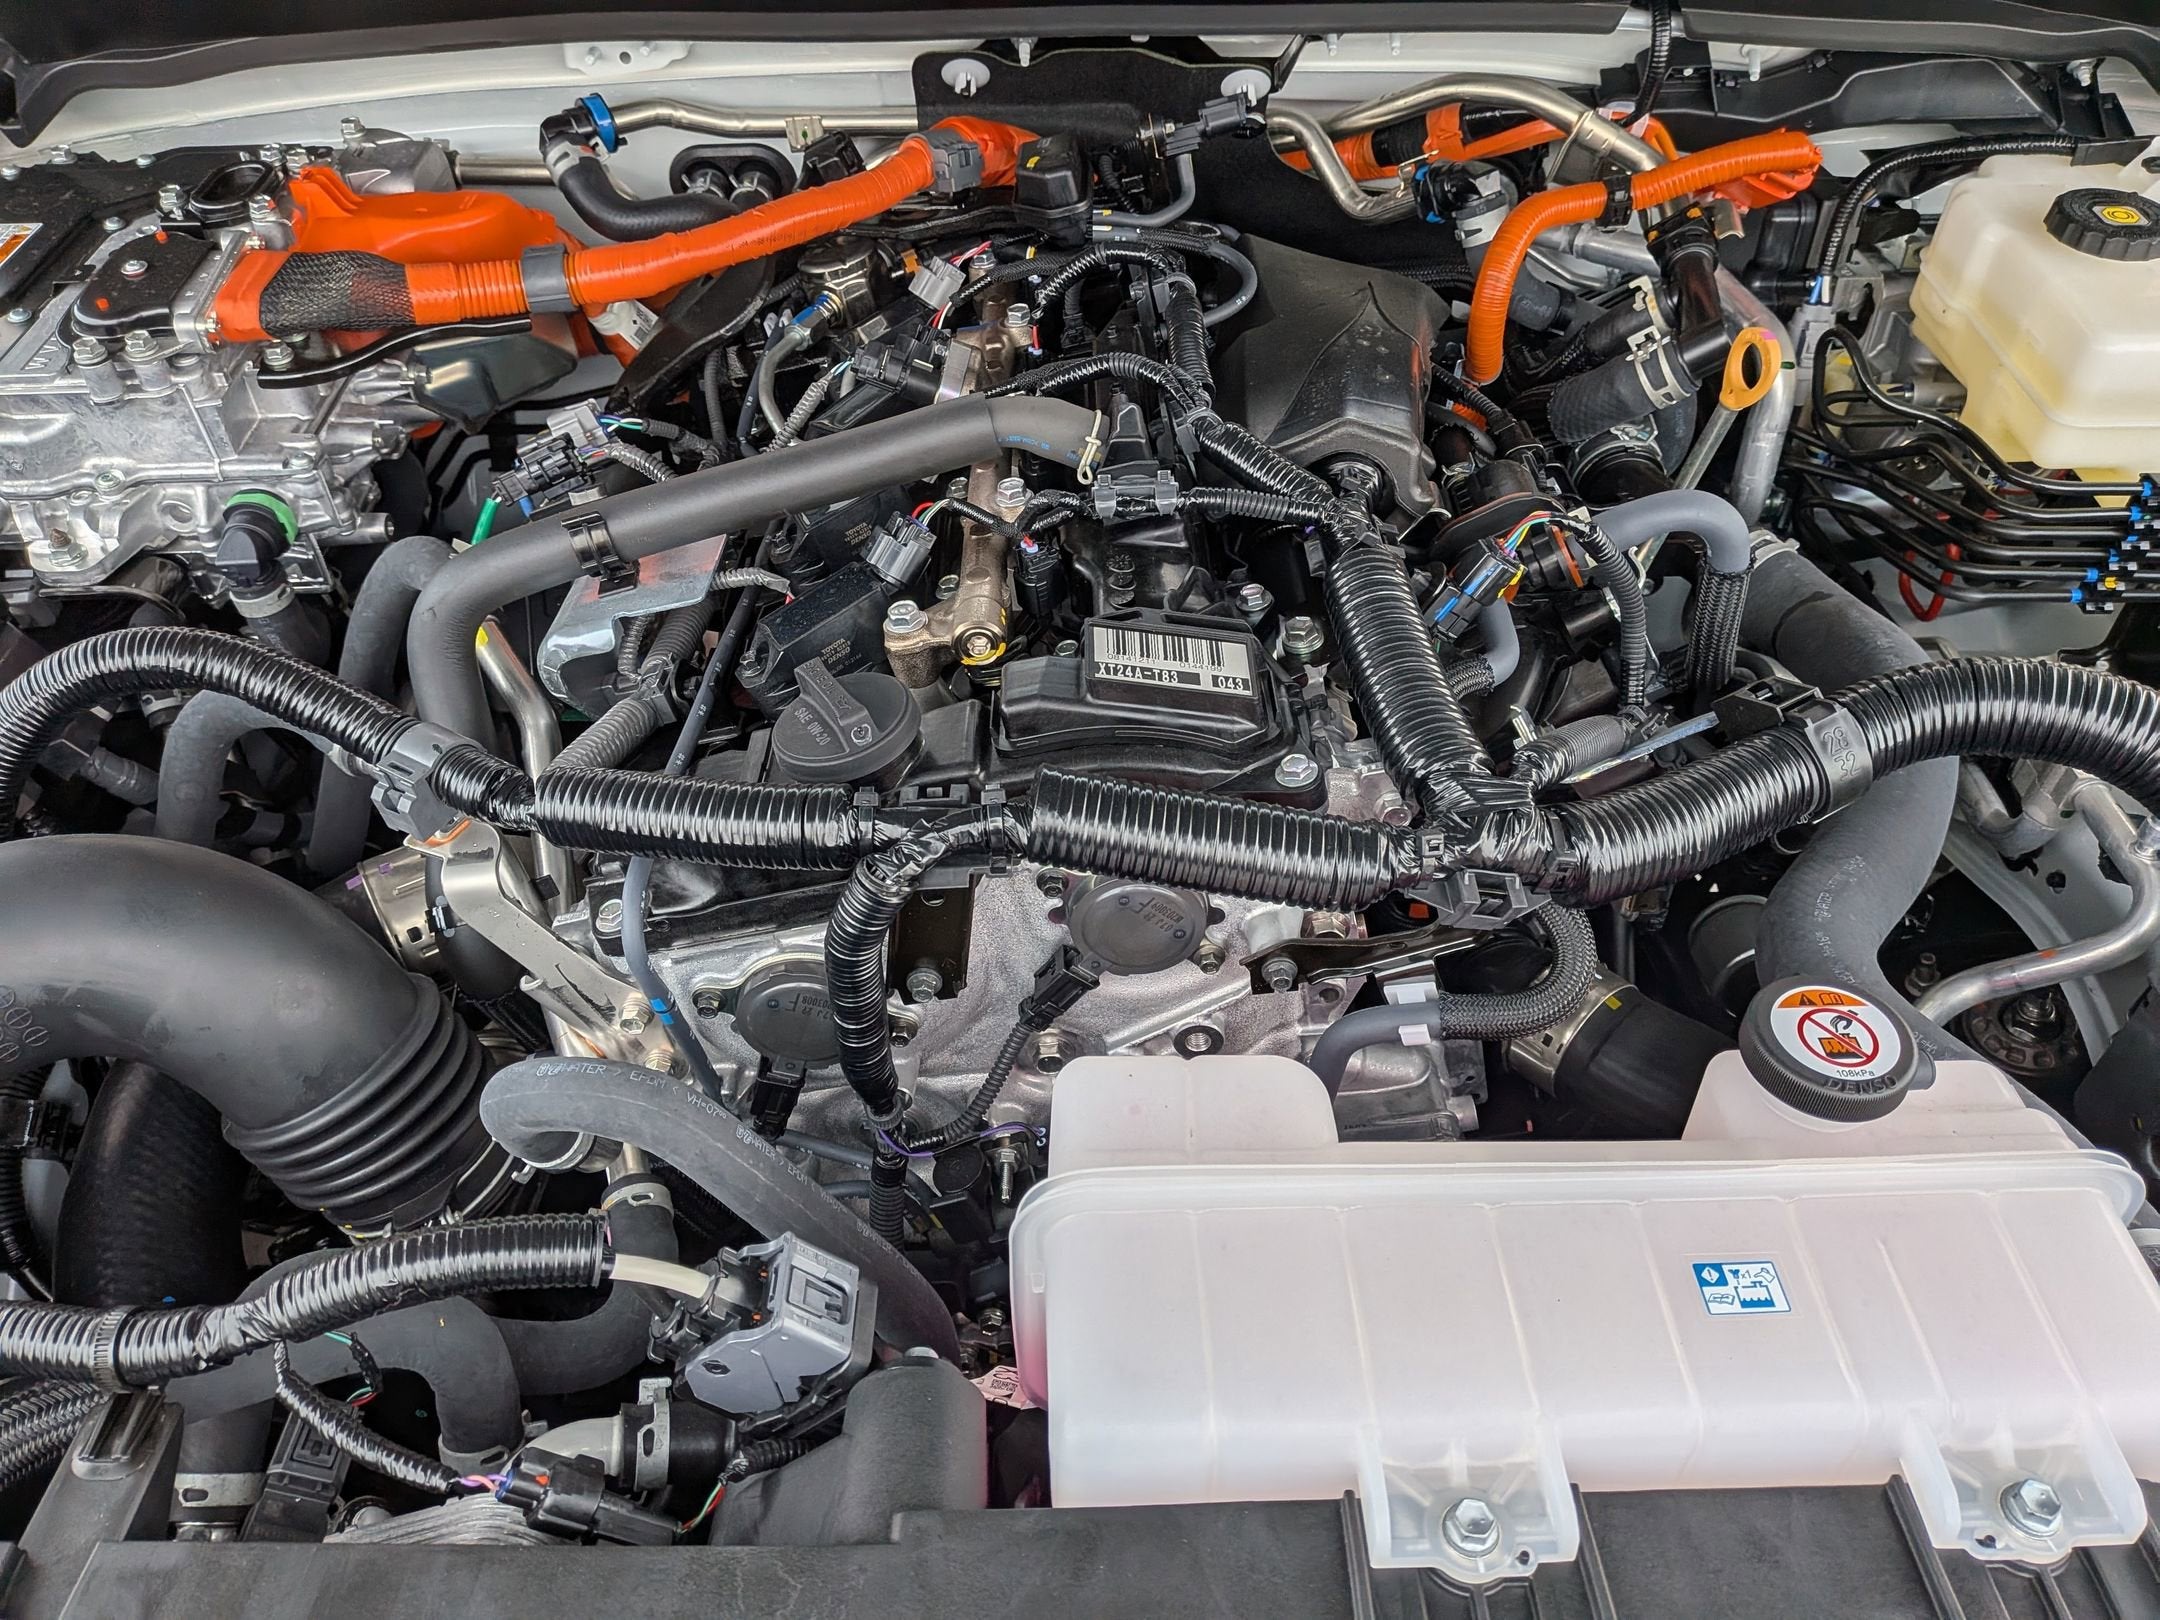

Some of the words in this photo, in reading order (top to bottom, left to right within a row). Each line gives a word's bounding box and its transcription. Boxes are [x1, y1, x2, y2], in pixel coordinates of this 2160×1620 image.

[821, 638, 846, 655] TOYOTA
[827, 646, 851, 665] DENSO
[1098, 662, 1179, 683] XT24A-T83
[1217, 678, 1244, 690] 043
[794, 707, 813, 723] SAE
[1822, 726, 1850, 756] 28
[1833, 750, 1863, 781] 32
[1835, 1068, 1876, 1079] 108kPa
[1823, 1075, 1899, 1096] DENSO
